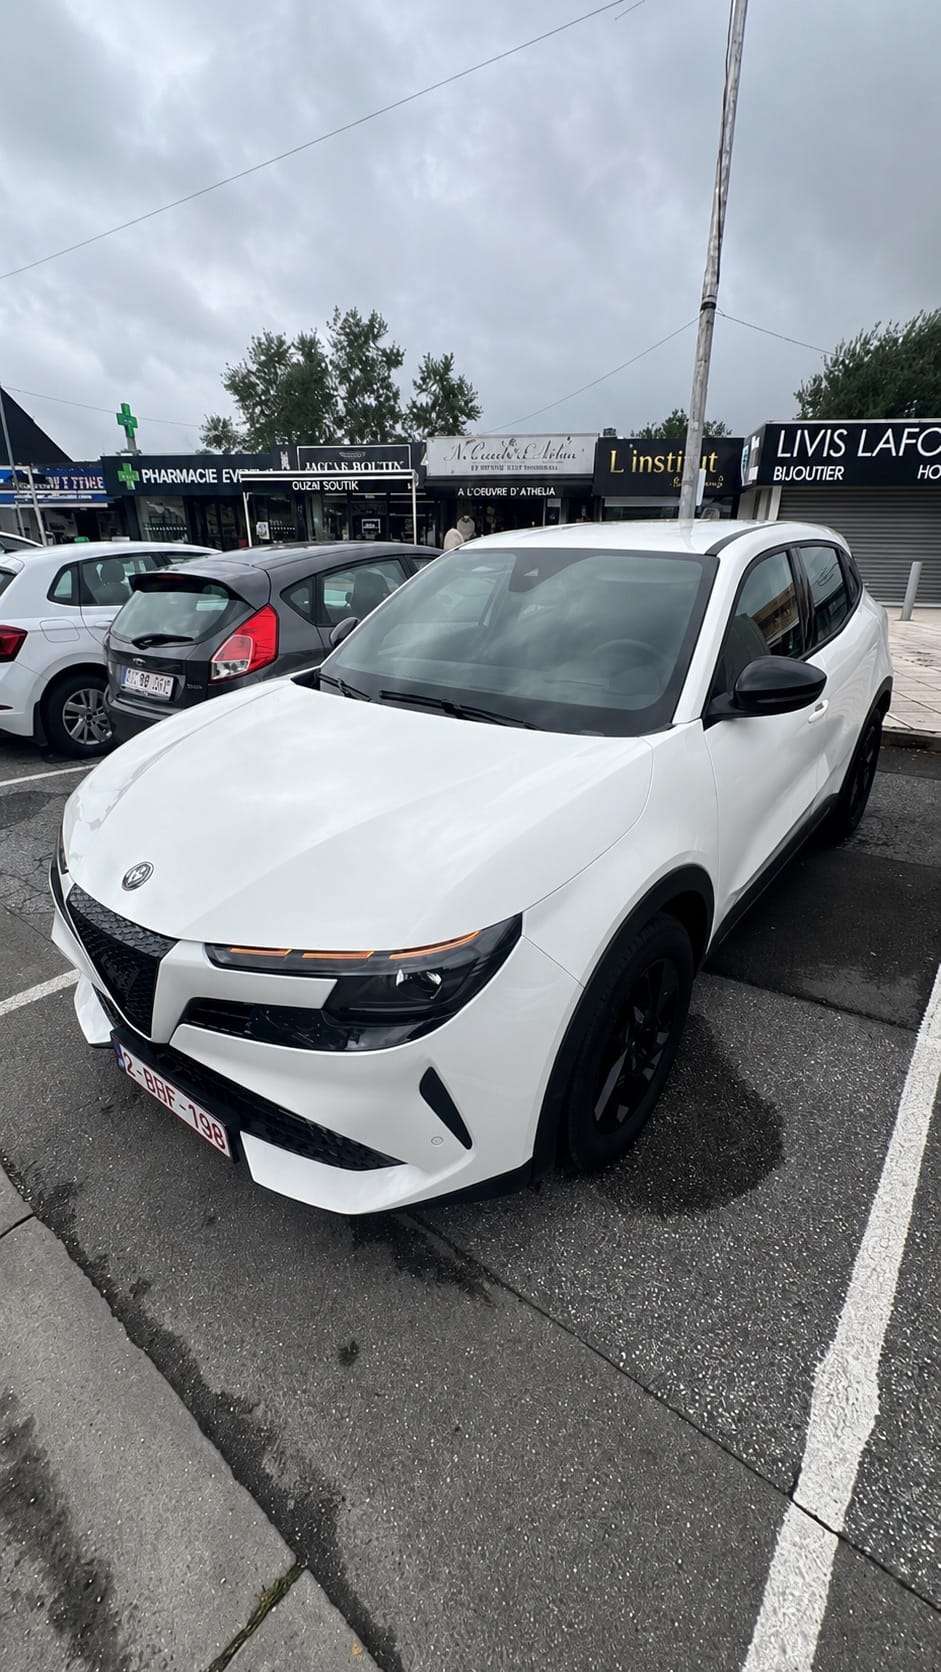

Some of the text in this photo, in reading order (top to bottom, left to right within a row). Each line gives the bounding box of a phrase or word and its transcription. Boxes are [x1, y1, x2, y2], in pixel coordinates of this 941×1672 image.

[777, 428, 848, 458] LIVIS
[141, 468, 218, 484] PHARMACIE
[773, 465, 845, 481] BIJOUTIER
